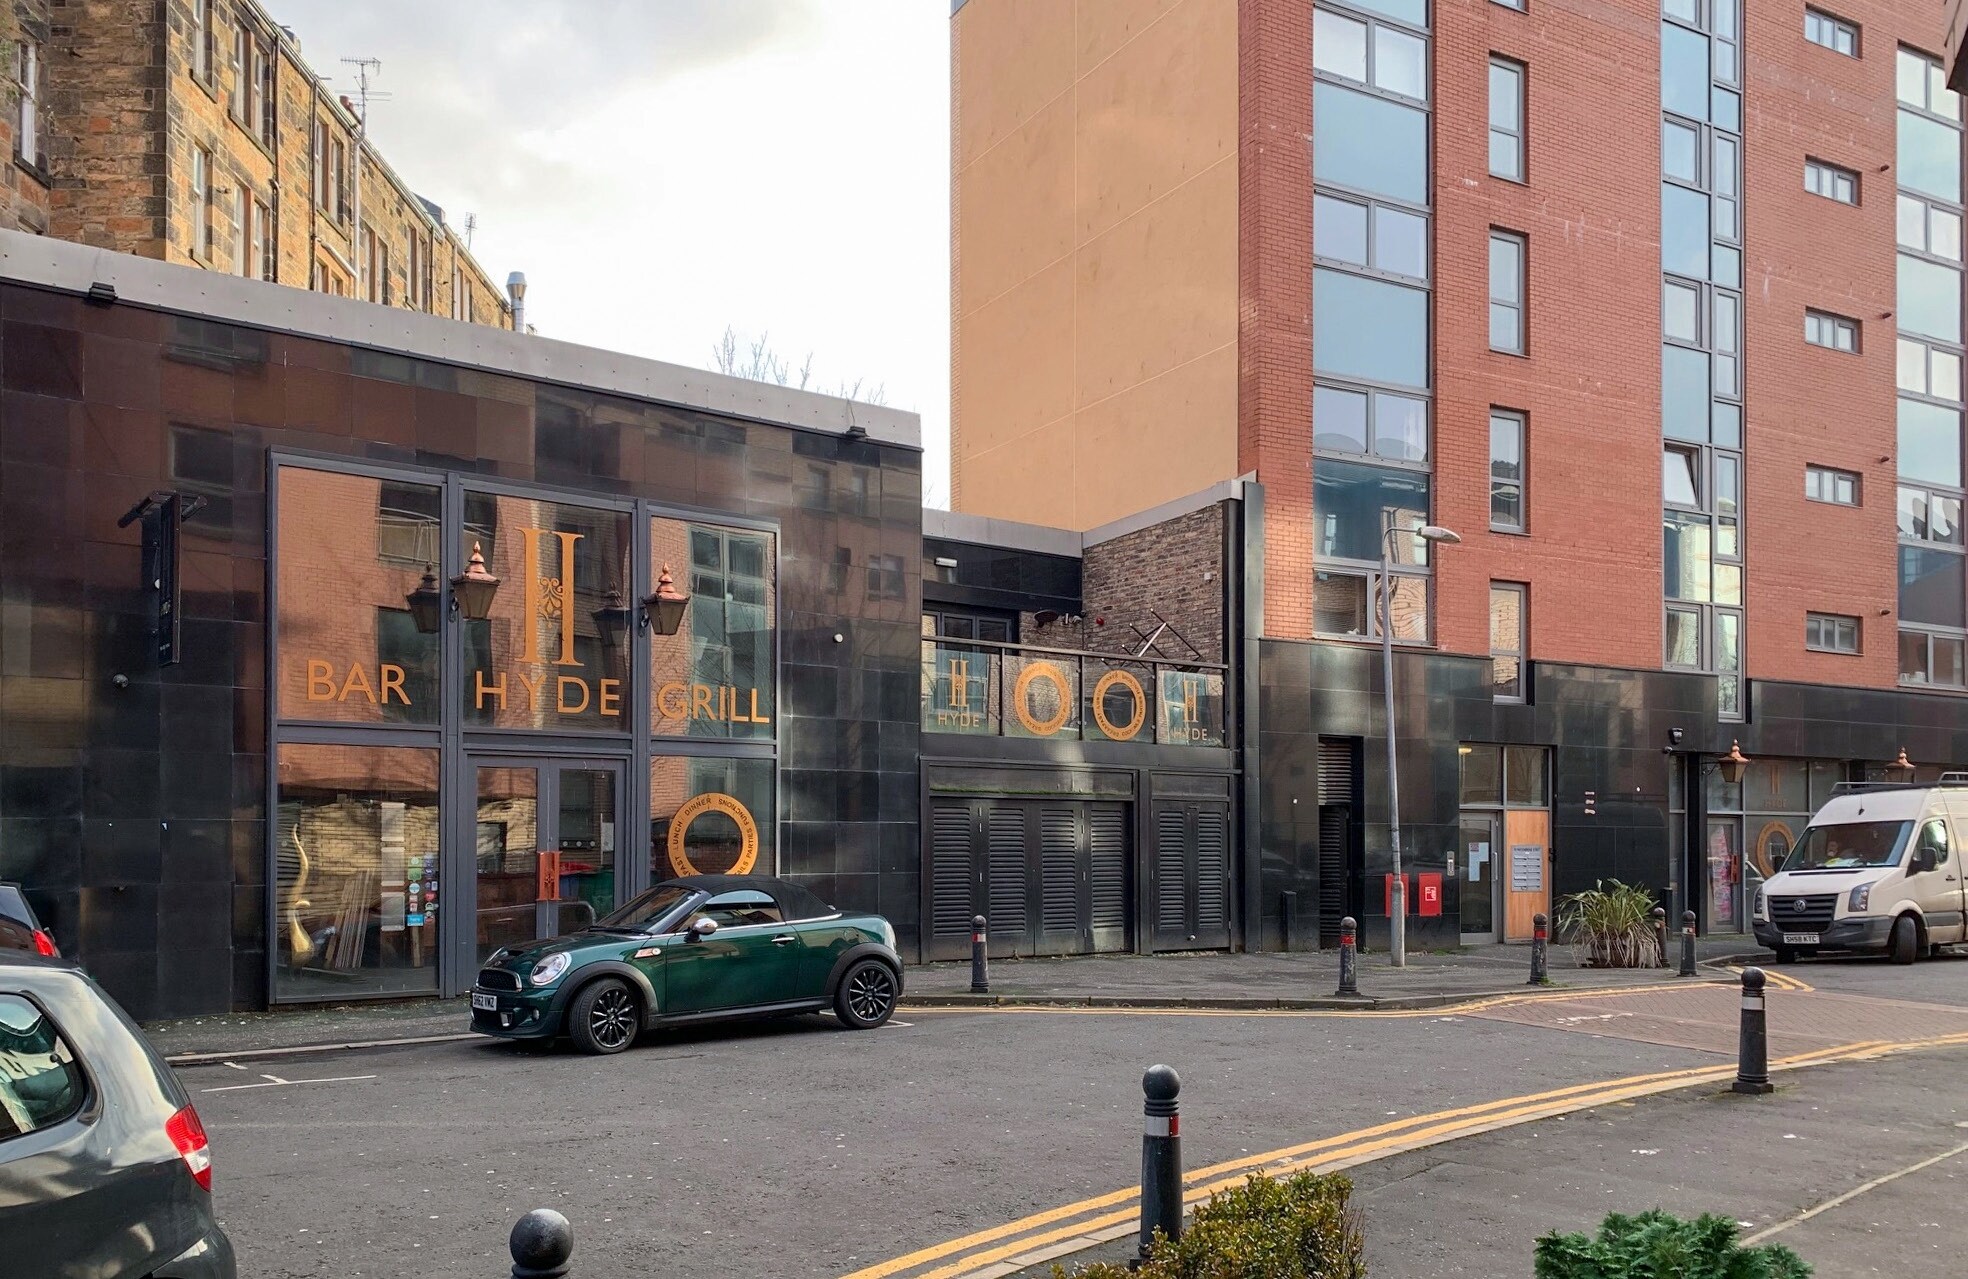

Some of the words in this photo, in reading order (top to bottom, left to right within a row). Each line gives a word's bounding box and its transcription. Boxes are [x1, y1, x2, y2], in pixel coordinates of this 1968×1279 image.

[307, 659, 412, 705] BAR
[476, 671, 620, 716] HYDE
[657, 682, 770, 724] GRILL
[938, 713, 980, 728] HYDE
[1173, 727, 1208, 740] HYDE
[673, 821, 683, 851] LUNCH
[684, 797, 712, 816] DINNER
[718, 798, 750, 826] FUNCTIONS
[745, 827, 754, 858] PARTIES
